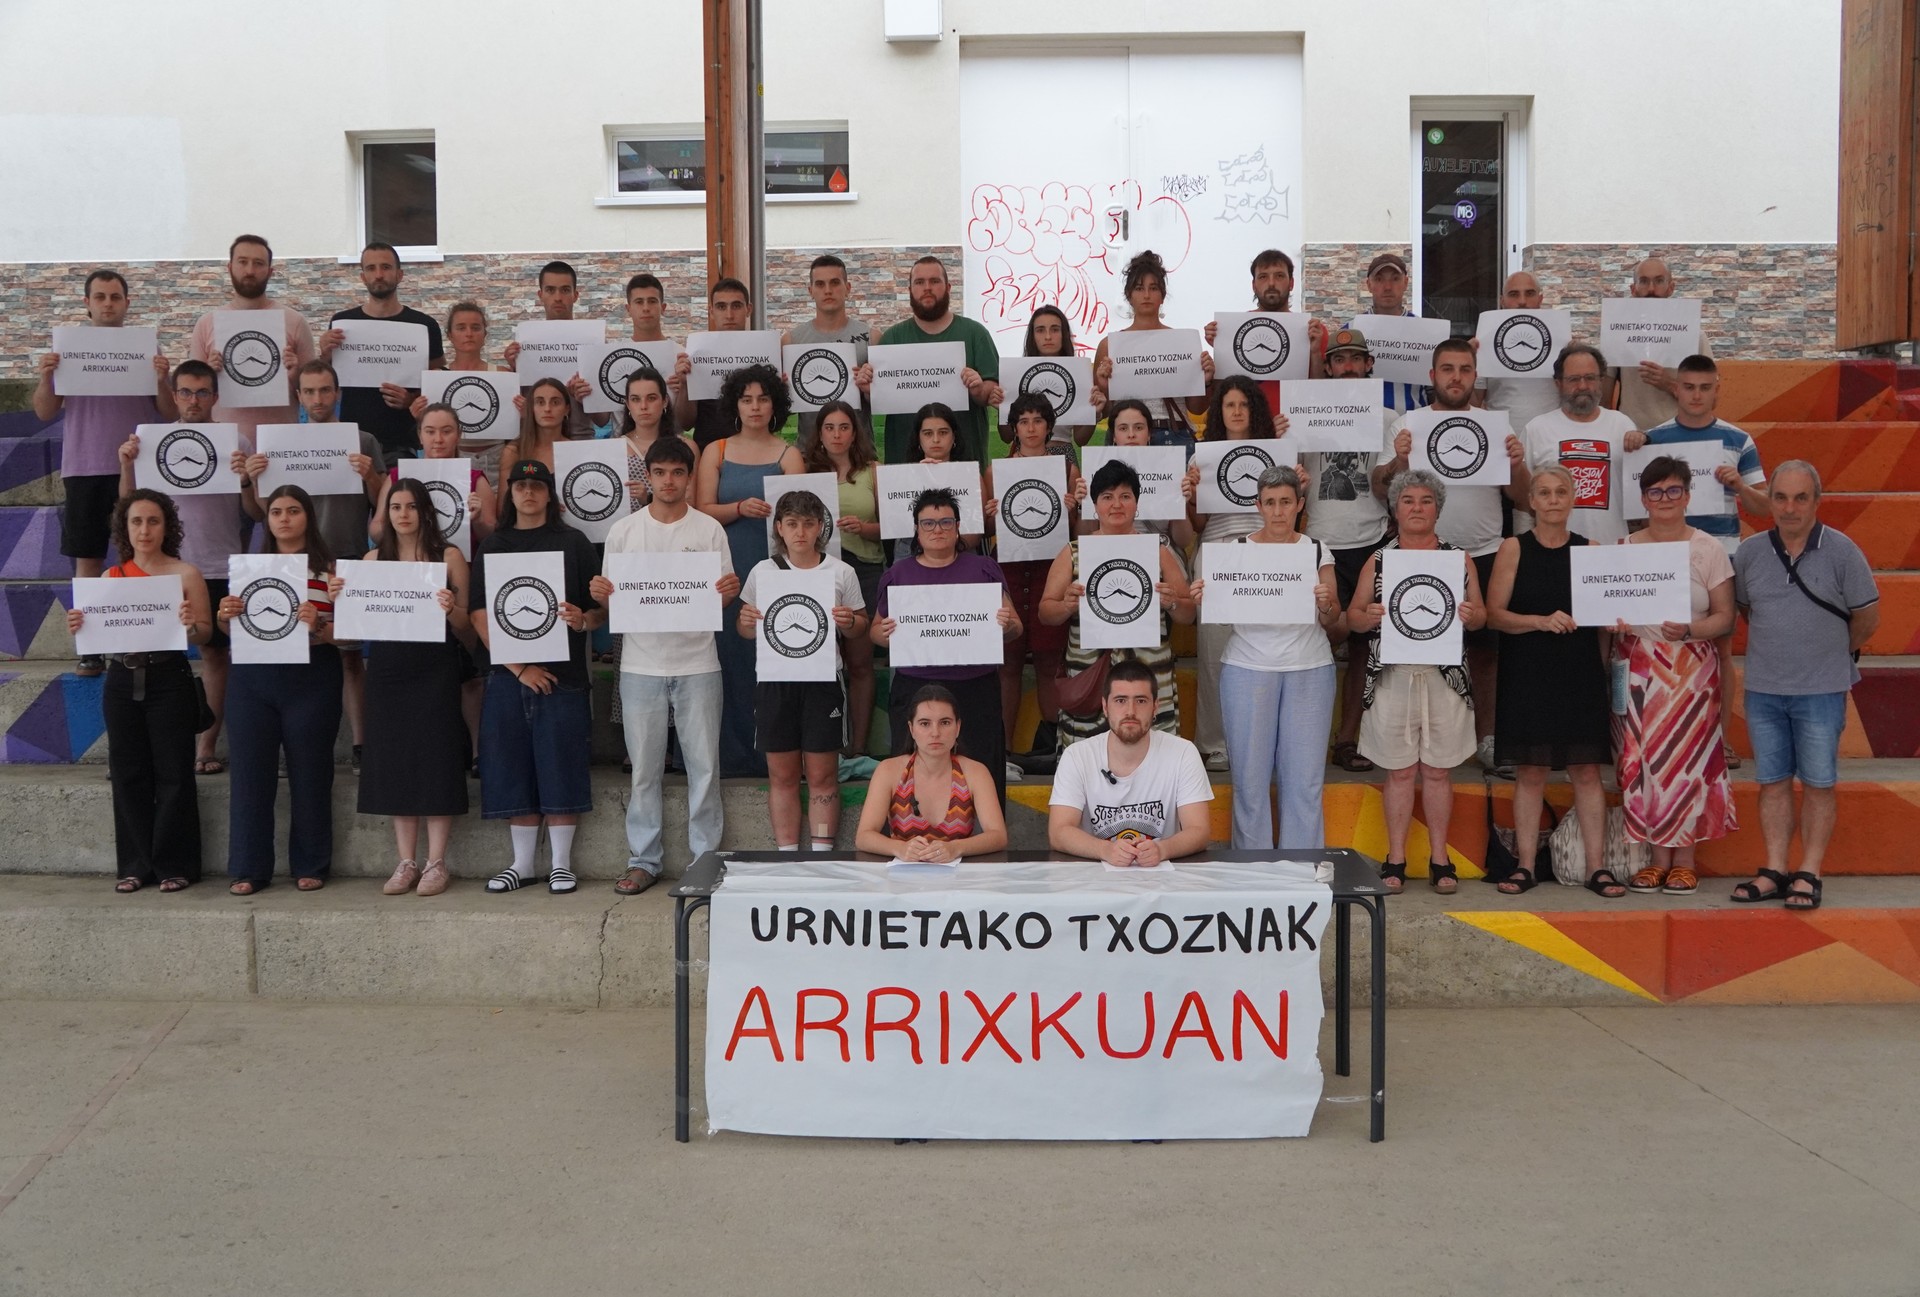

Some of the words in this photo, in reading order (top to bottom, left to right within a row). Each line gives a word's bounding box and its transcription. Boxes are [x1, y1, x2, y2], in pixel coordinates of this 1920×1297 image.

[1609, 322, 1652, 331] URNIETAKO
[1652, 323, 1688, 332] TXOZNAK
[1365, 339, 1402, 349] RNIETAKO
[1626, 335, 1672, 344] ARRIXKUAN!
[339, 343, 381, 352] URNIETAKO
[381, 344, 417, 353] TXOZNAK
[520, 343, 561, 352] URNIETAKO
[62, 351, 107, 360] URNIETAKO
[107, 352, 146, 361] TXOZNAK
[357, 356, 401, 365] ARRIXKUAN!
[538, 355, 578, 364] ARRIXKUAN
[692, 356, 734, 365] URNIETAKO
[734, 355, 771, 364] TXOZNAK
[1115, 354, 1157, 365] URNIETAKO
[1157, 353, 1193, 362] TXOZNAK
[1375, 352, 1420, 363] ARRIXKUAN!
[82, 364, 129, 373] ARRIXKUAN!
[877, 368, 920, 378] URNIETAKO
[920, 367, 956, 376] TXOZNAK
[1133, 366, 1178, 376] ARRIXKUAN!
[896, 380, 941, 390] ARRIXKUAN!
[1289, 405, 1333, 415] URNIETAKO
[1333, 405, 1371, 414] TXOZNAK
[1307, 419, 1354, 428] ARRIXKUAN!
[264, 450, 309, 459] URNIETAKO
[310, 449, 348, 458] TXOZNAK
[285, 462, 332, 471] ARRIXKUAN!
[1569, 465, 1606, 478] RISTON
[887, 490, 921, 500] URNIETA
[1575, 487, 1602, 499] ABIL
[1212, 572, 1261, 582] URNIETAKO
[1261, 572, 1302, 582] TXOZNAK
[1582, 574, 1632, 584] URNIETAKO
[1633, 572, 1676, 583] TXOZNAK
[618, 581, 667, 591] URNIETAKO
[667, 580, 708, 590] TXOZNAK
[345, 589, 392, 599] URNIETAKO
[393, 590, 433, 600] TXOZNAK
[1232, 587, 1284, 597] ARRIXKUAN!
[1603, 588, 1657, 598] ARRIXKUAN!
[639, 595, 690, 605] ARRIXKUAN!
[82, 605, 132, 614] URNIETAKO
[130, 603, 171, 612] TXOZNAK
[364, 604, 414, 614] ARRIXKUAN!
[104, 617, 155, 628] ARRIXKUAN!
[899, 614, 947, 624] URNIETAKO
[948, 613, 989, 623] TXOZNAK
[919, 628, 971, 638] ARRIXKUAN!
[1093, 813, 1161, 833] SKATEBOARDING
[750, 904, 1053, 951] URNIETAKO
[1069, 901, 1319, 954] TXOZNAK
[724, 985, 1289, 1066] ARRIXKUAN
